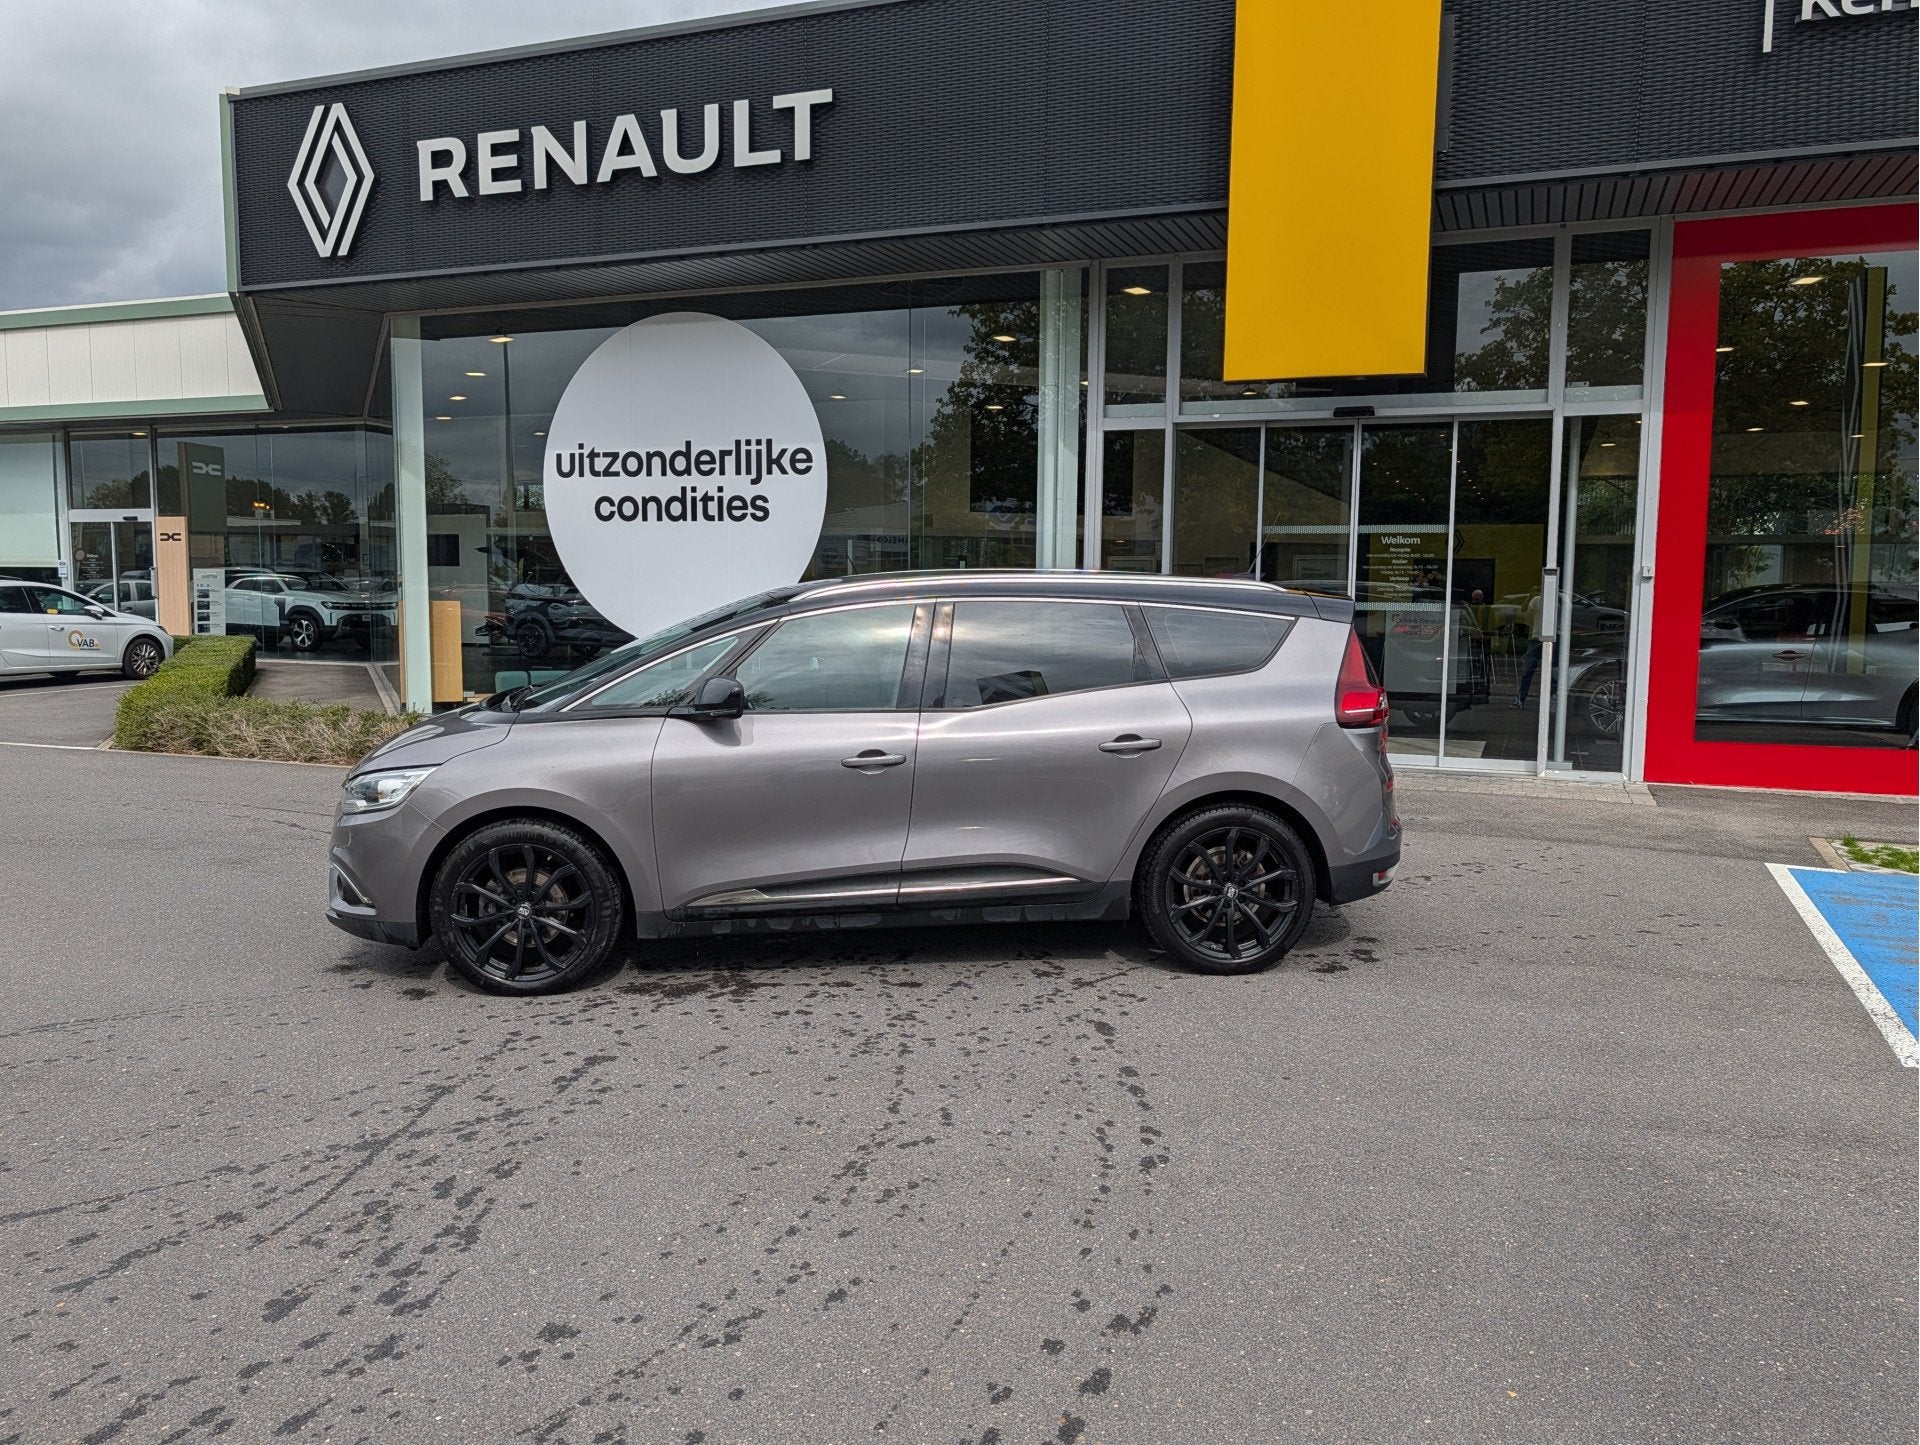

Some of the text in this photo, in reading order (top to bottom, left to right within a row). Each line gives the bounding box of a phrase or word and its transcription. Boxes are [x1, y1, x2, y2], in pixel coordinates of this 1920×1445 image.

[417, 88, 834, 202] RENAULT
[556, 438, 814, 485] uitzonderlijke
[595, 486, 770, 522] condities
[1381, 536, 1421, 545] Welkom
[77, 638, 95, 648] VAB
